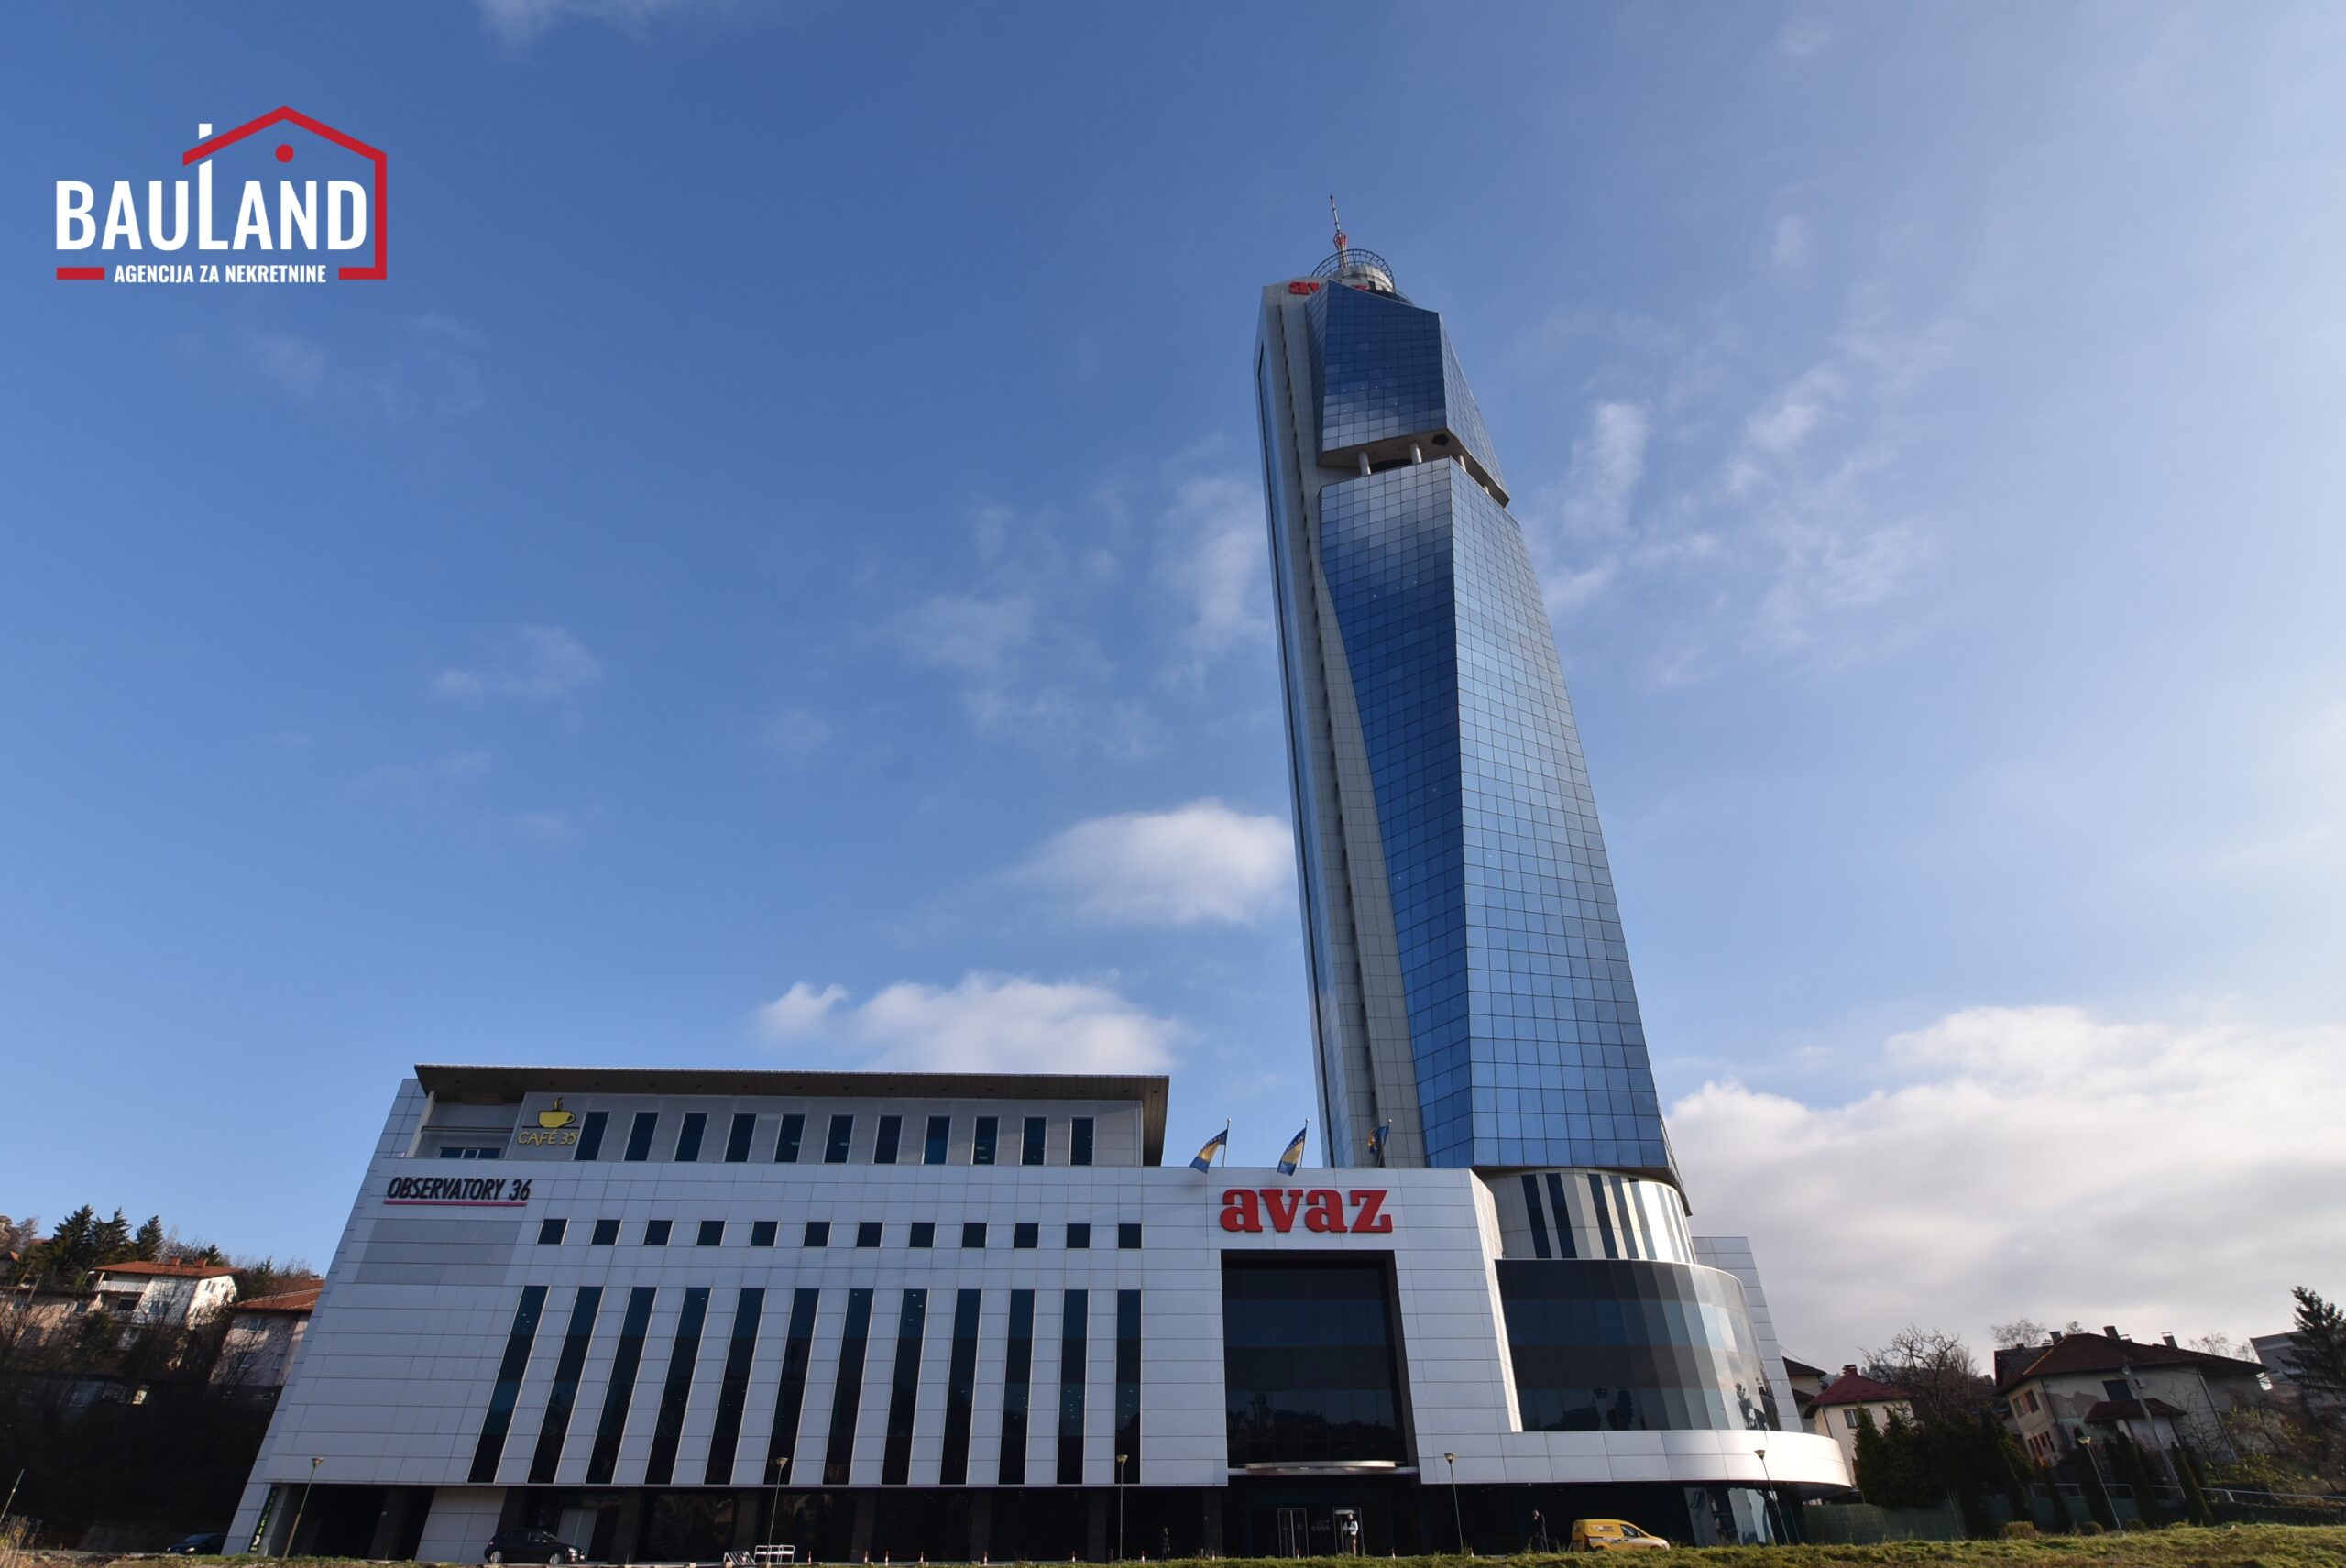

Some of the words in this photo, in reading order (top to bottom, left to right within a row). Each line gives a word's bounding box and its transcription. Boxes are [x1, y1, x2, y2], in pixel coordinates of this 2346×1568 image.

[518, 1129, 558, 1146] CAFÉ
[560, 1132, 578, 1145] 35
[388, 1177, 506, 1200] OBSERVATORY
[509, 1179, 532, 1201] 36
[1220, 1189, 1393, 1233] avaz
